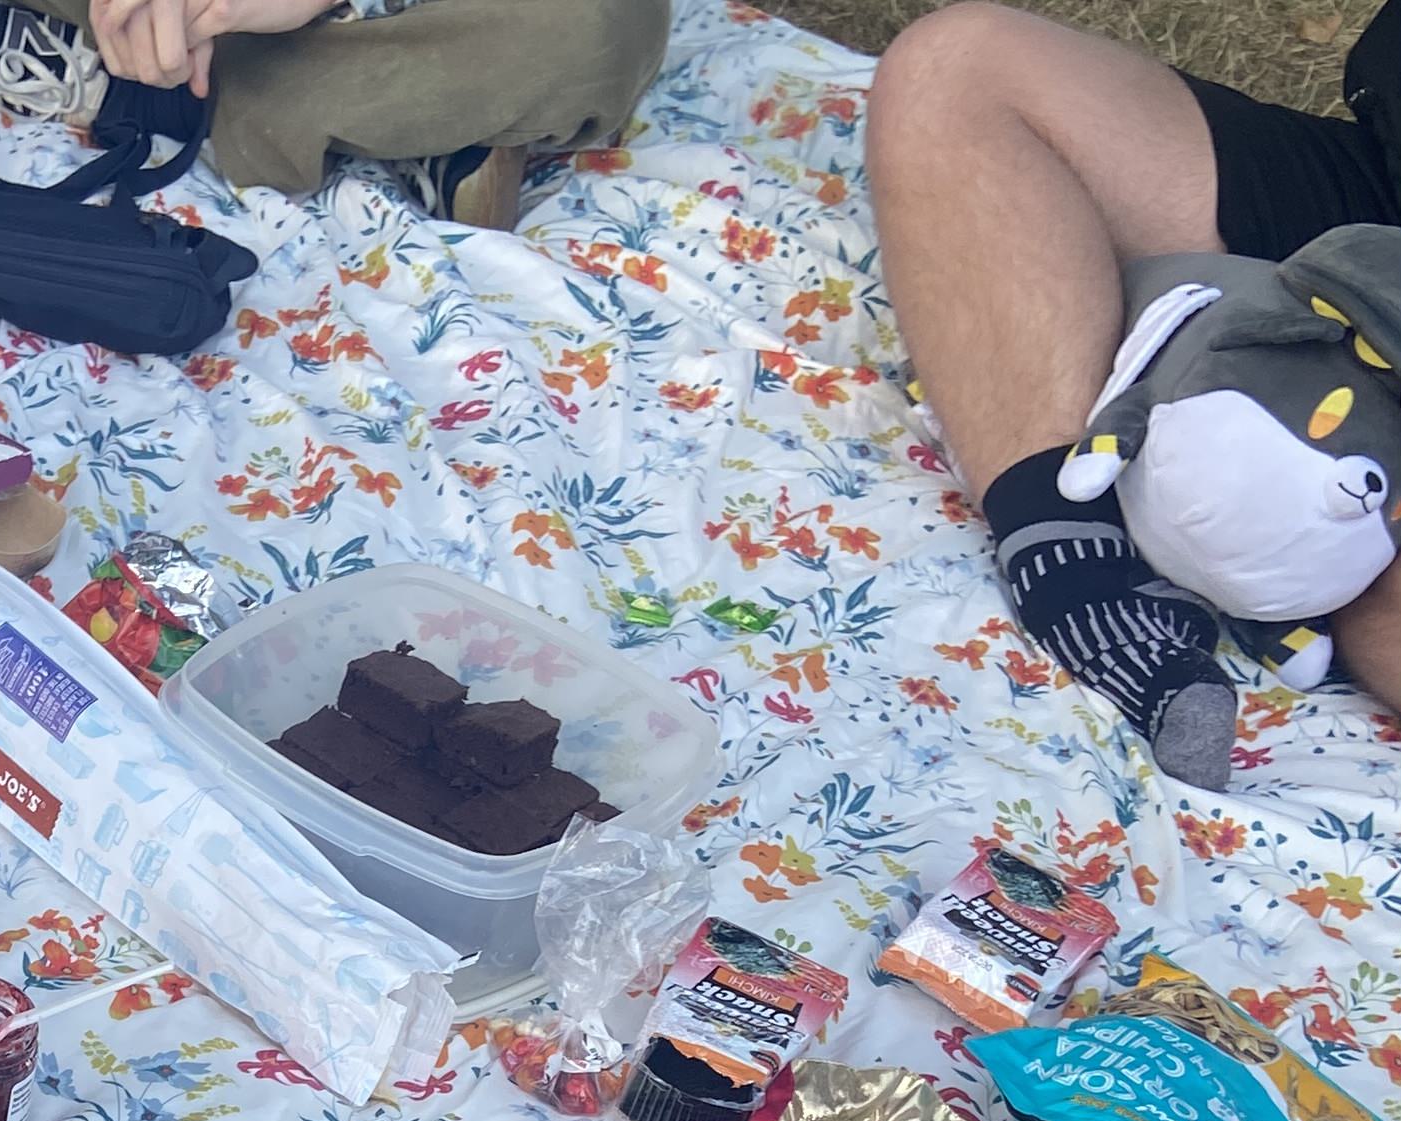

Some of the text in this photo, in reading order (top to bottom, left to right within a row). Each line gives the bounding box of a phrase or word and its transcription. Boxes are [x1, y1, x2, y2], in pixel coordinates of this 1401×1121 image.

[941, 893, 1066, 973] Seaweed
[966, 896, 1058, 956] Snack
[999, 900, 1046, 932] KIMCHI
[693, 979, 795, 1032] Snack
[727, 974, 780, 1004] KIMCHI
[1023, 1057, 1140, 1102] CORN
